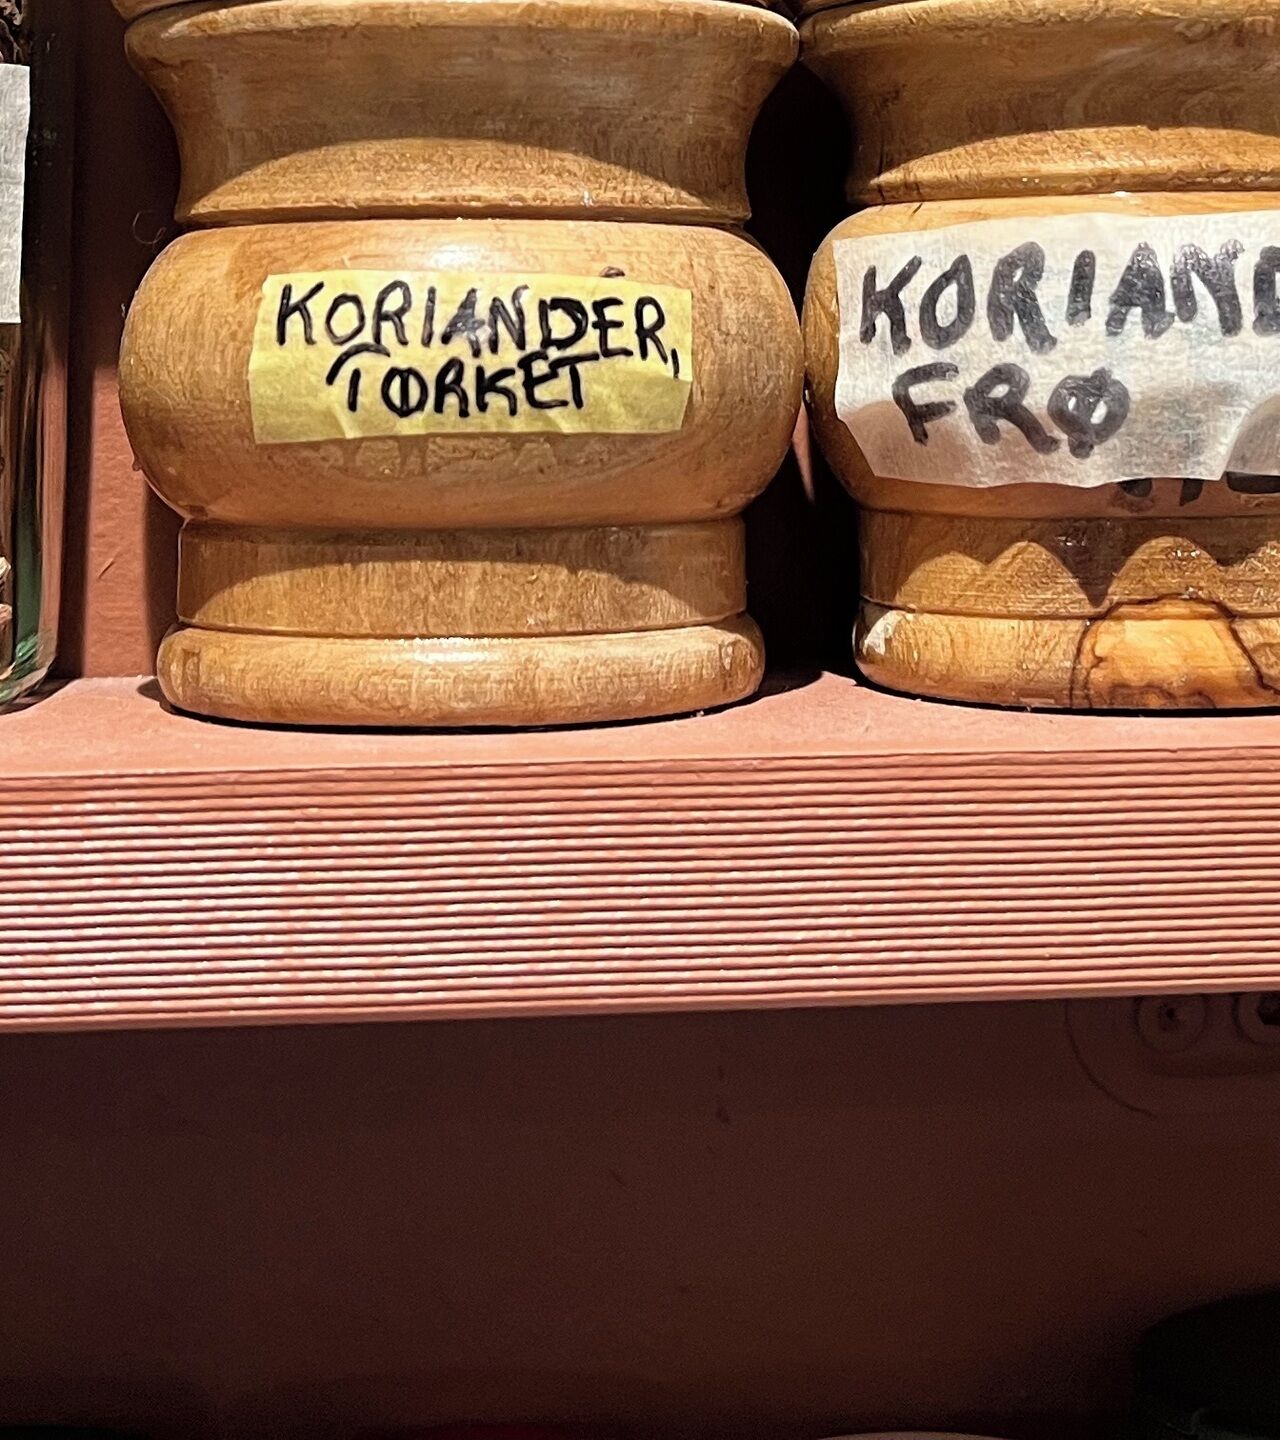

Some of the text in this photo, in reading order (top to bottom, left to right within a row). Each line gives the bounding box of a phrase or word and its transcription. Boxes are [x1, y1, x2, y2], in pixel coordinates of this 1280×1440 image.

[275, 279, 681, 379] KORIANDER,
[325, 342, 601, 418] TØRKET
[891, 360, 1132, 459] FRØ
